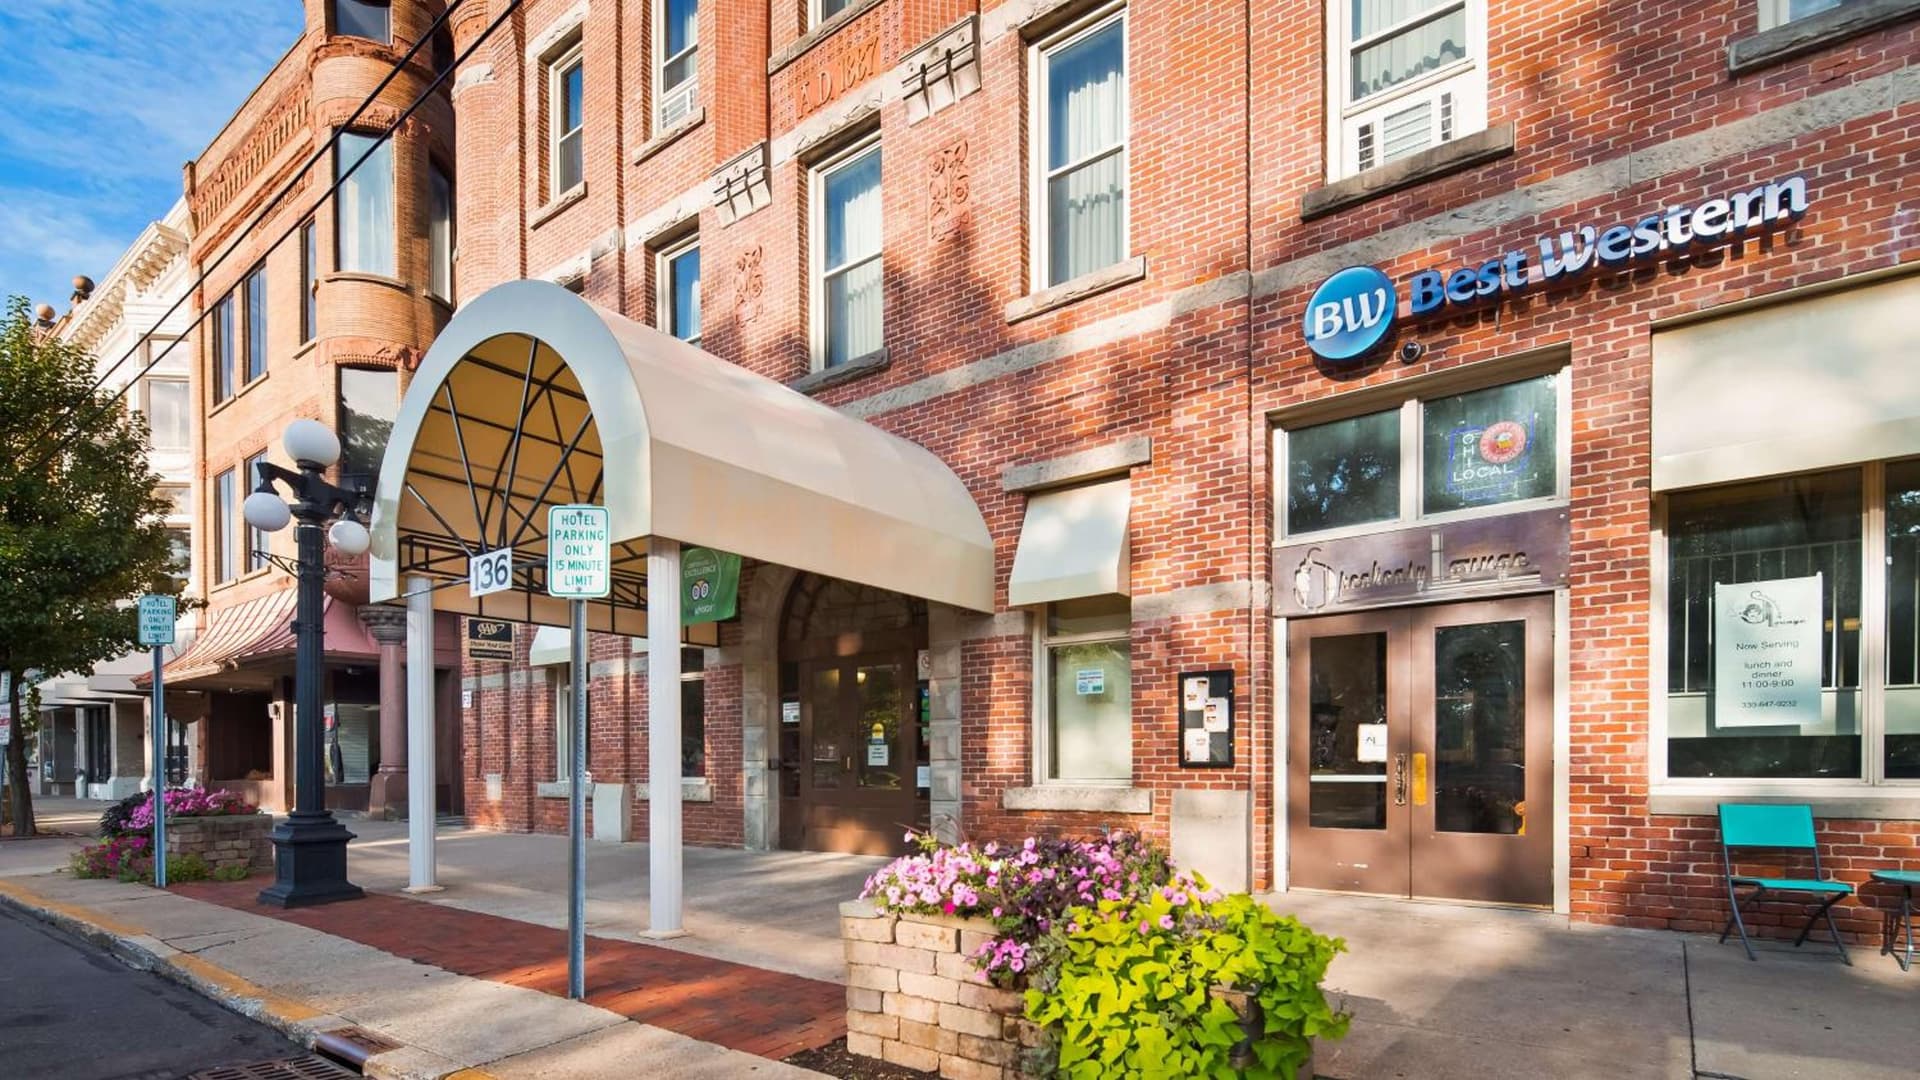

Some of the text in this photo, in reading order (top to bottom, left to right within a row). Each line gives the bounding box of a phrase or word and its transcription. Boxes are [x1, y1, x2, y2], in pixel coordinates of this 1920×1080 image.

[1314, 176, 1811, 340] BW Best Western
[1462, 433, 1475, 480] OHIO
[1453, 463, 1515, 482] LOCAL
[561, 514, 597, 526] HOTEL
[555, 529, 604, 541] PARKING
[564, 544, 593, 556] ONLY
[1431, 533, 1530, 584] Lounge
[555, 560, 603, 571] 15 MINUTE
[473, 554, 508, 591] 136
[564, 575, 593, 586] LIMIT
[1736, 640, 1799, 651] Now Serving
[1744, 660, 1793, 669] lunch and
[1751, 671, 1782, 679] dinner
